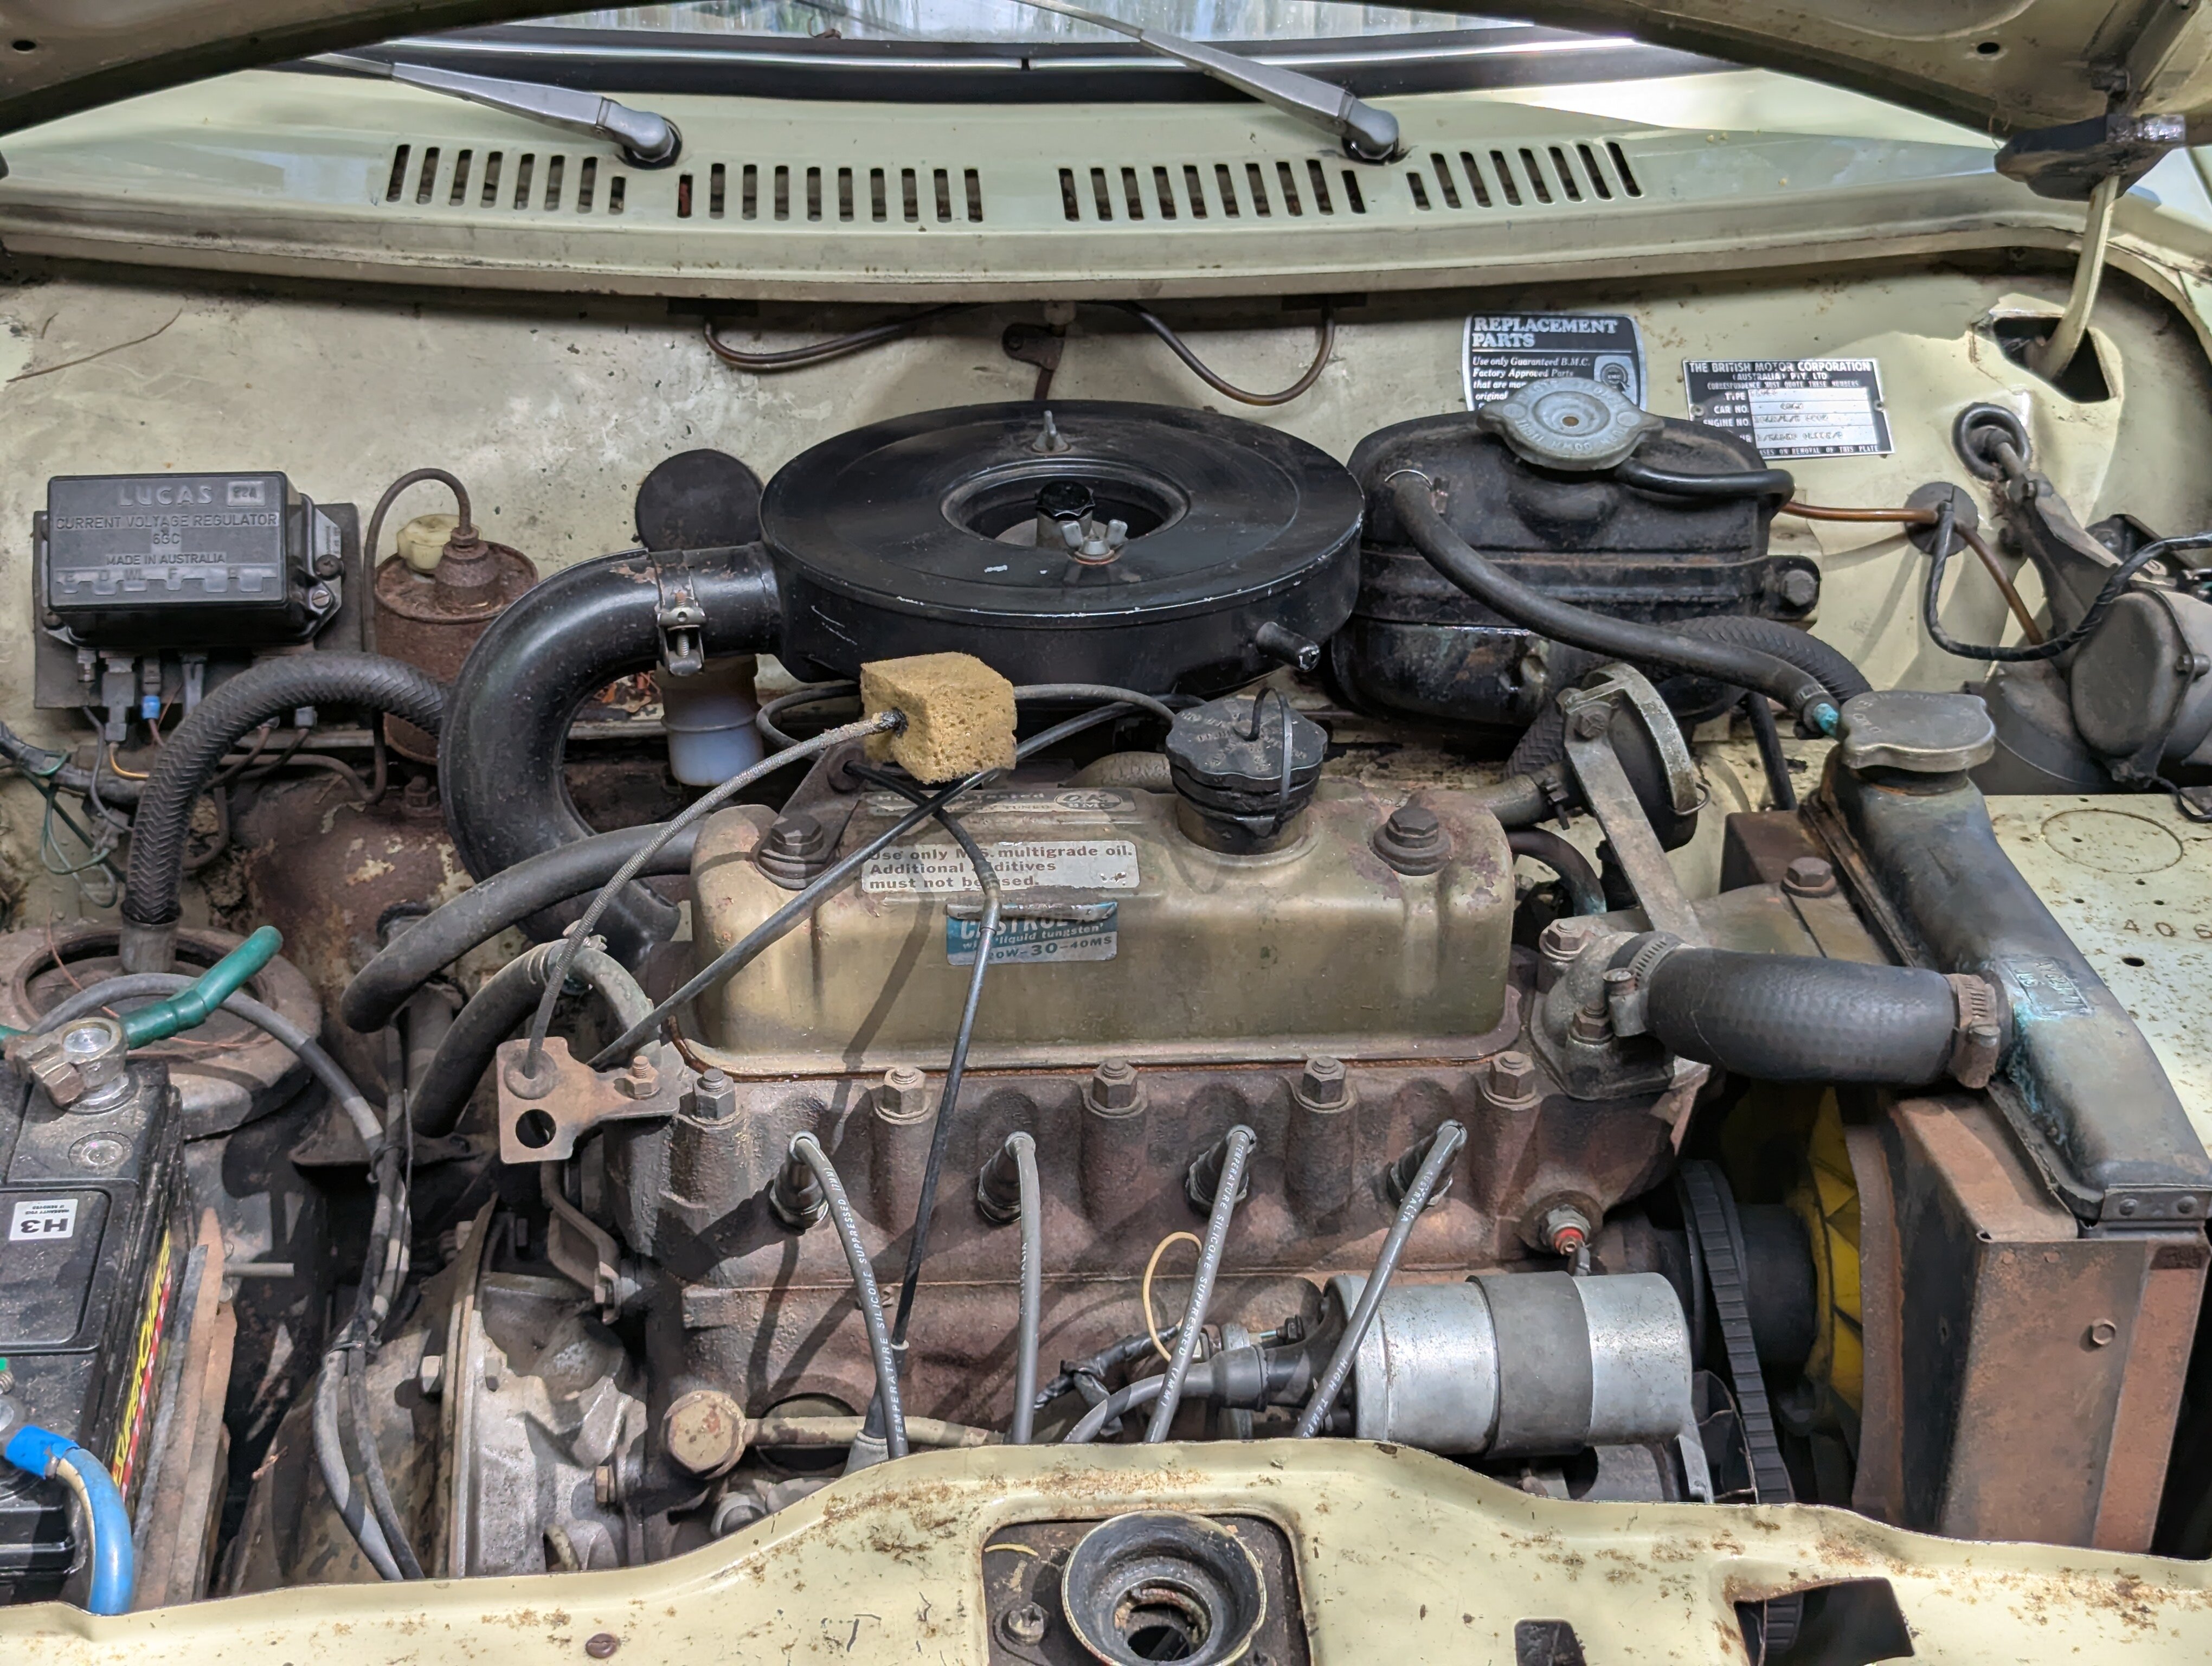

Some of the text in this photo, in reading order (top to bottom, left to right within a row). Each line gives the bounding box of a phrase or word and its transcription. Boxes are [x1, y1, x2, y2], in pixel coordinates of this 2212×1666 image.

[1474, 317, 1618, 334] REPLACEMENT
[1472, 333, 1535, 348] PARTS
[1472, 357, 1489, 366] Use
[1490, 357, 1509, 367] only
[1510, 357, 1559, 367] Guaranteed
[1689, 361, 1871, 373] THE BRITISH MOTOR CORPORATION
[1472, 368, 1506, 379] Factory
[1508, 369, 1549, 379] Approved
[1474, 381, 1490, 389] that
[1475, 391, 1509, 402] original
[1713, 405, 1732, 414] CAR
[119, 485, 213, 507] LUCAS
[56, 513, 278, 529] CURRENT VOLTAGE REGULATOR
[107, 553, 226, 566] MADE IN AUSTRALIA
[869, 850, 902, 861] Use
[910, 849, 948, 861] only
[998, 846, 1098, 858] multigrade
[1105, 845, 1133, 856] oil.
[870, 862, 964, 874] Additional
[870, 877, 916, 889] must
[924, 877, 954, 888] not
[1219, 1142, 1245, 1210] TEMPERATURE
[21, 1218, 69, 1234] H3
[837, 1199, 867, 1265] SUPPRESSED
[1203, 1214, 1225, 1270] SILICONE
[862, 1271, 885, 1329] SILICONE
[1178, 1276, 1208, 1356] SUPPRESSED
[1328, 1357, 1348, 1392] HIGH
[879, 1337, 905, 1442] TEMPERATURE
